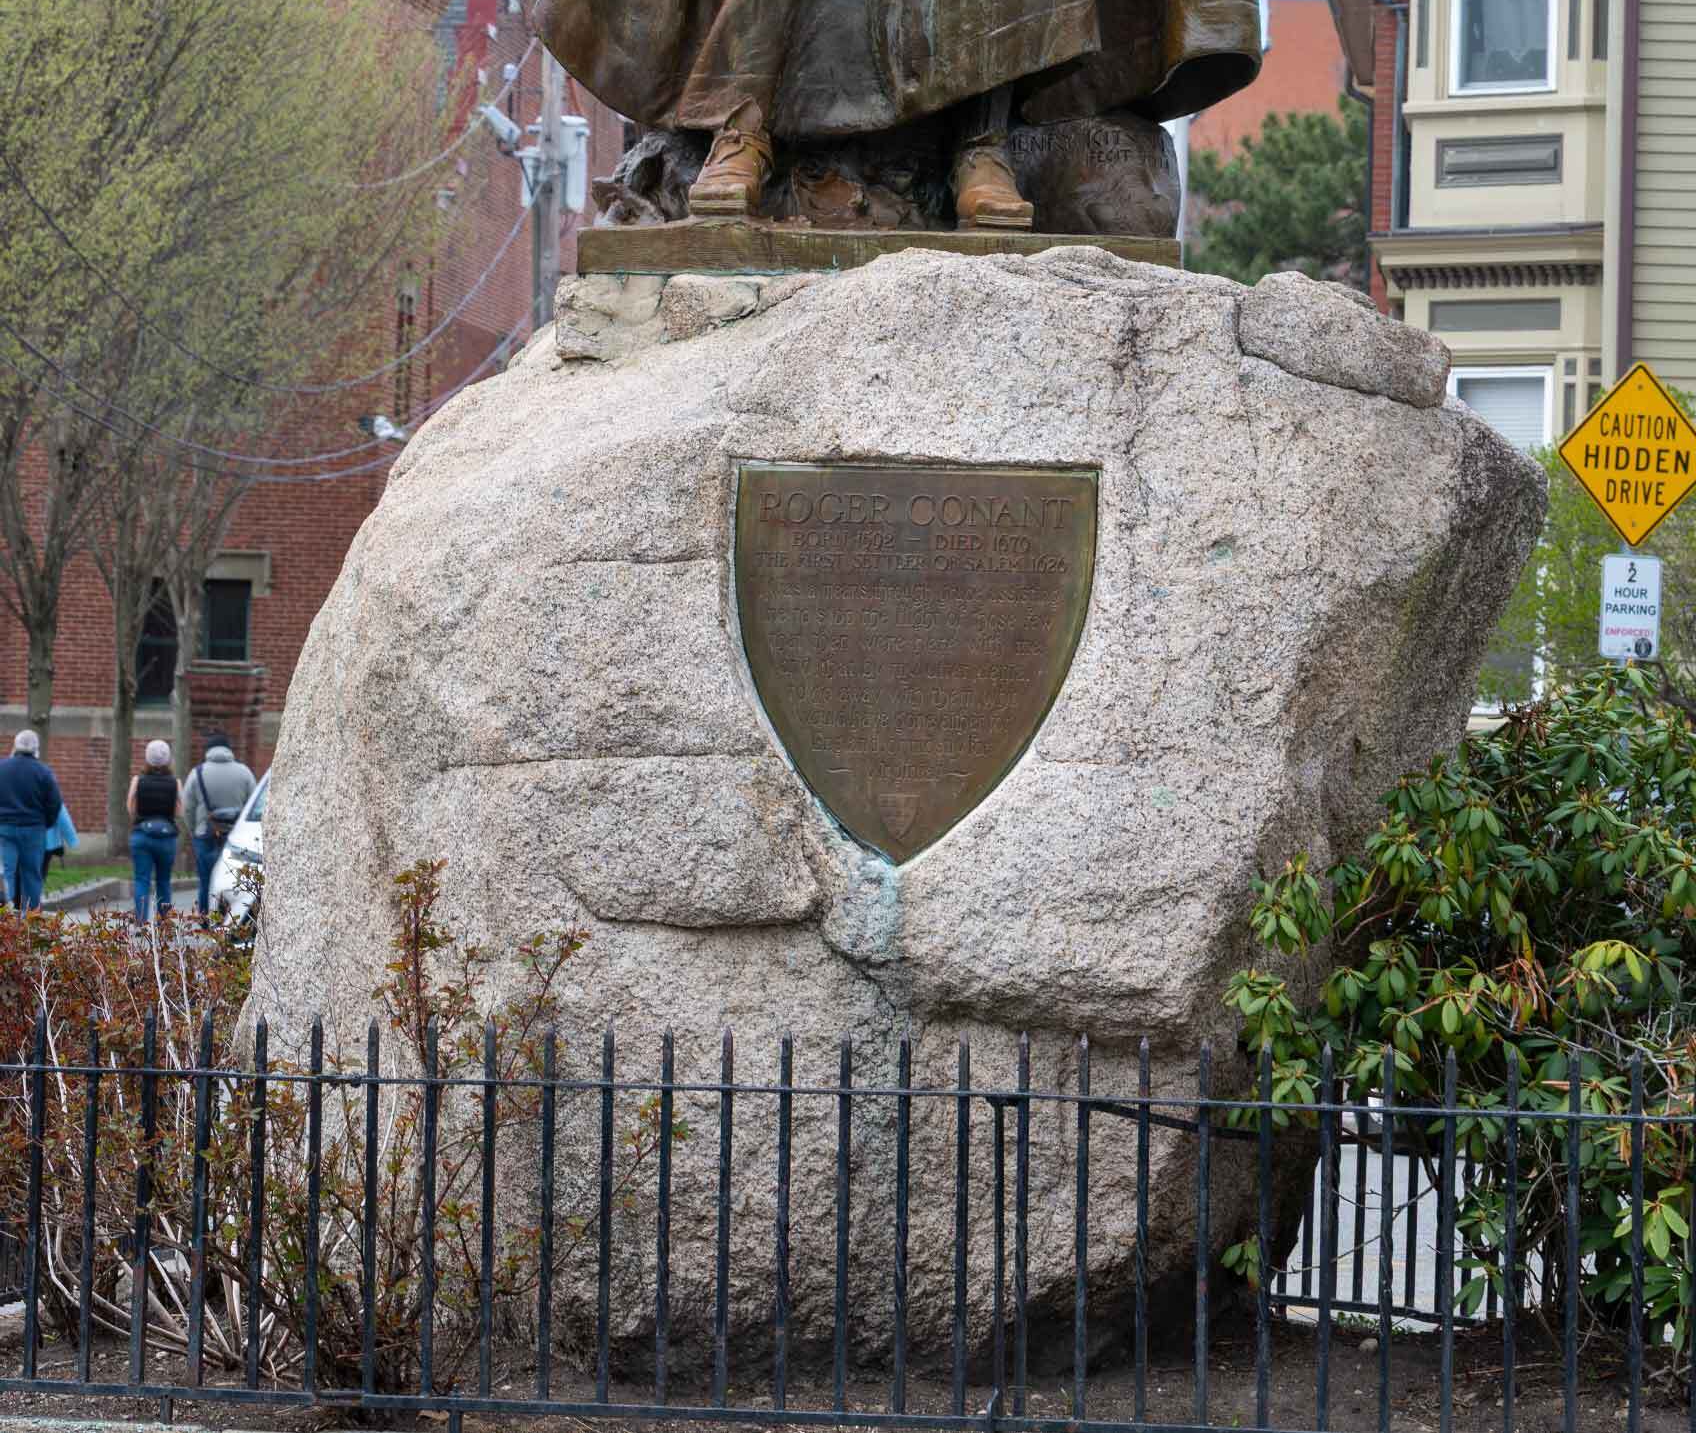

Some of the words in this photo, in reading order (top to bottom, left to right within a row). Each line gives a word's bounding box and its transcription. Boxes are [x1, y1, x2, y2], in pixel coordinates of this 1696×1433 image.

[1600, 412, 1677, 440] CAUTION
[1584, 444, 1691, 475] HIDDEN
[1605, 478, 1665, 507] DRIVE
[758, 492, 893, 525] ROGER
[907, 494, 1073, 529] CONANT
[791, 532, 848, 548] BORN
[935, 534, 984, 552] DIED
[757, 551, 788, 569] THE
[799, 551, 843, 569] FIRST
[853, 552, 925, 571] SETTLER
[933, 554, 961, 572] OF
[962, 554, 1026, 573] SALEM
[1627, 566, 1637, 583] 2
[1614, 587, 1648, 600] HOUR
[1605, 602, 1656, 616] PARKING
